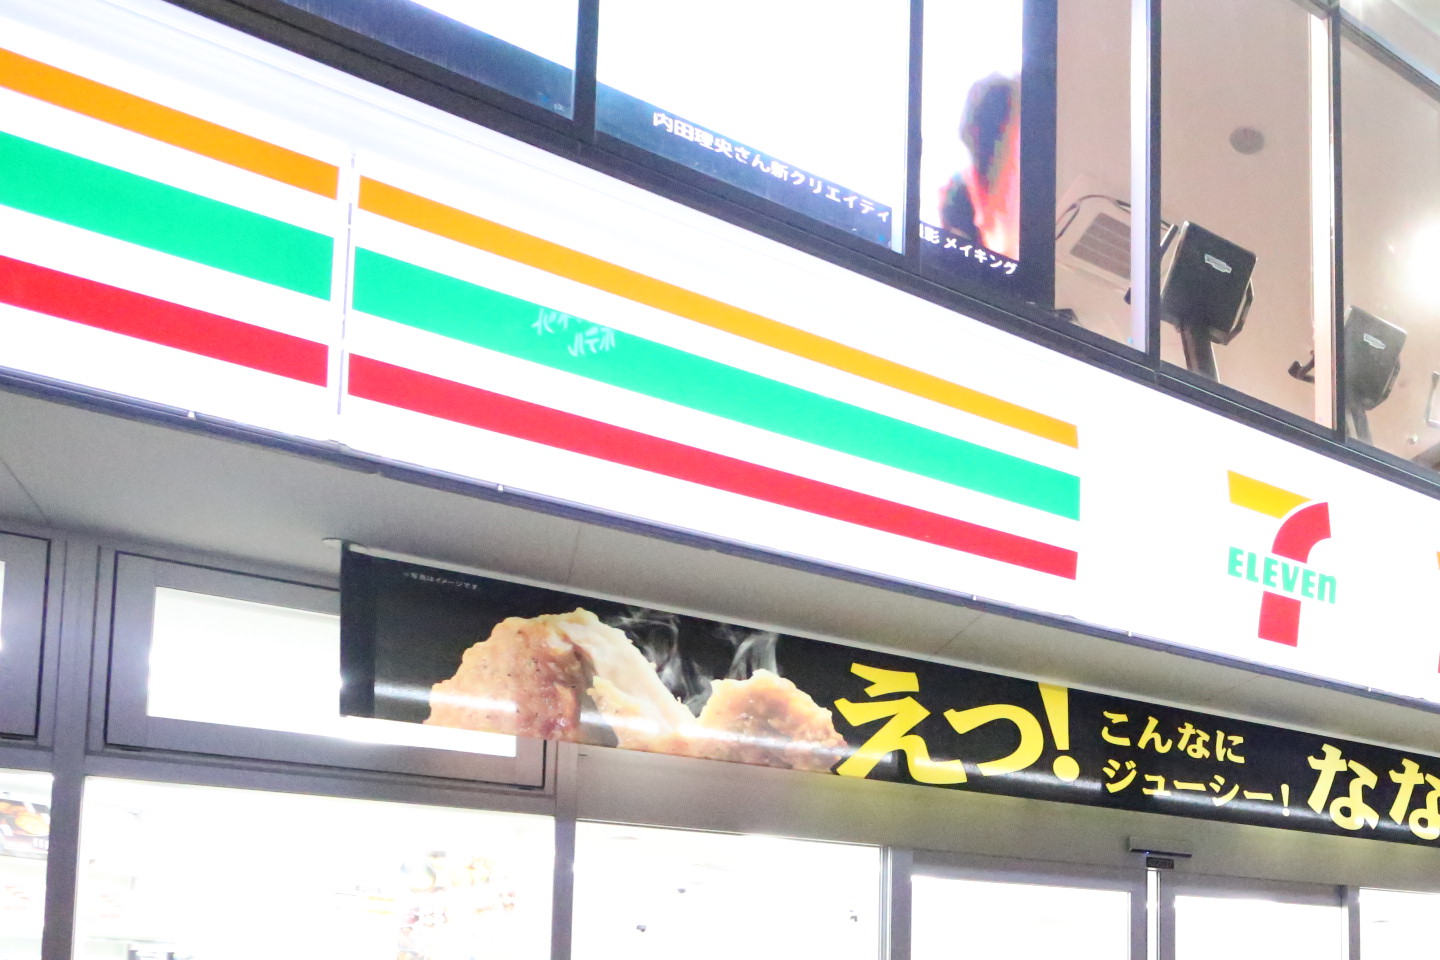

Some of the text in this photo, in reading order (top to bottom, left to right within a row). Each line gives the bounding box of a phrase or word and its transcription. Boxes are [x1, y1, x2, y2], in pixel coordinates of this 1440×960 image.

[944, 235, 1018, 275] メイキング
[1102, 711, 1245, 765] こんなに
